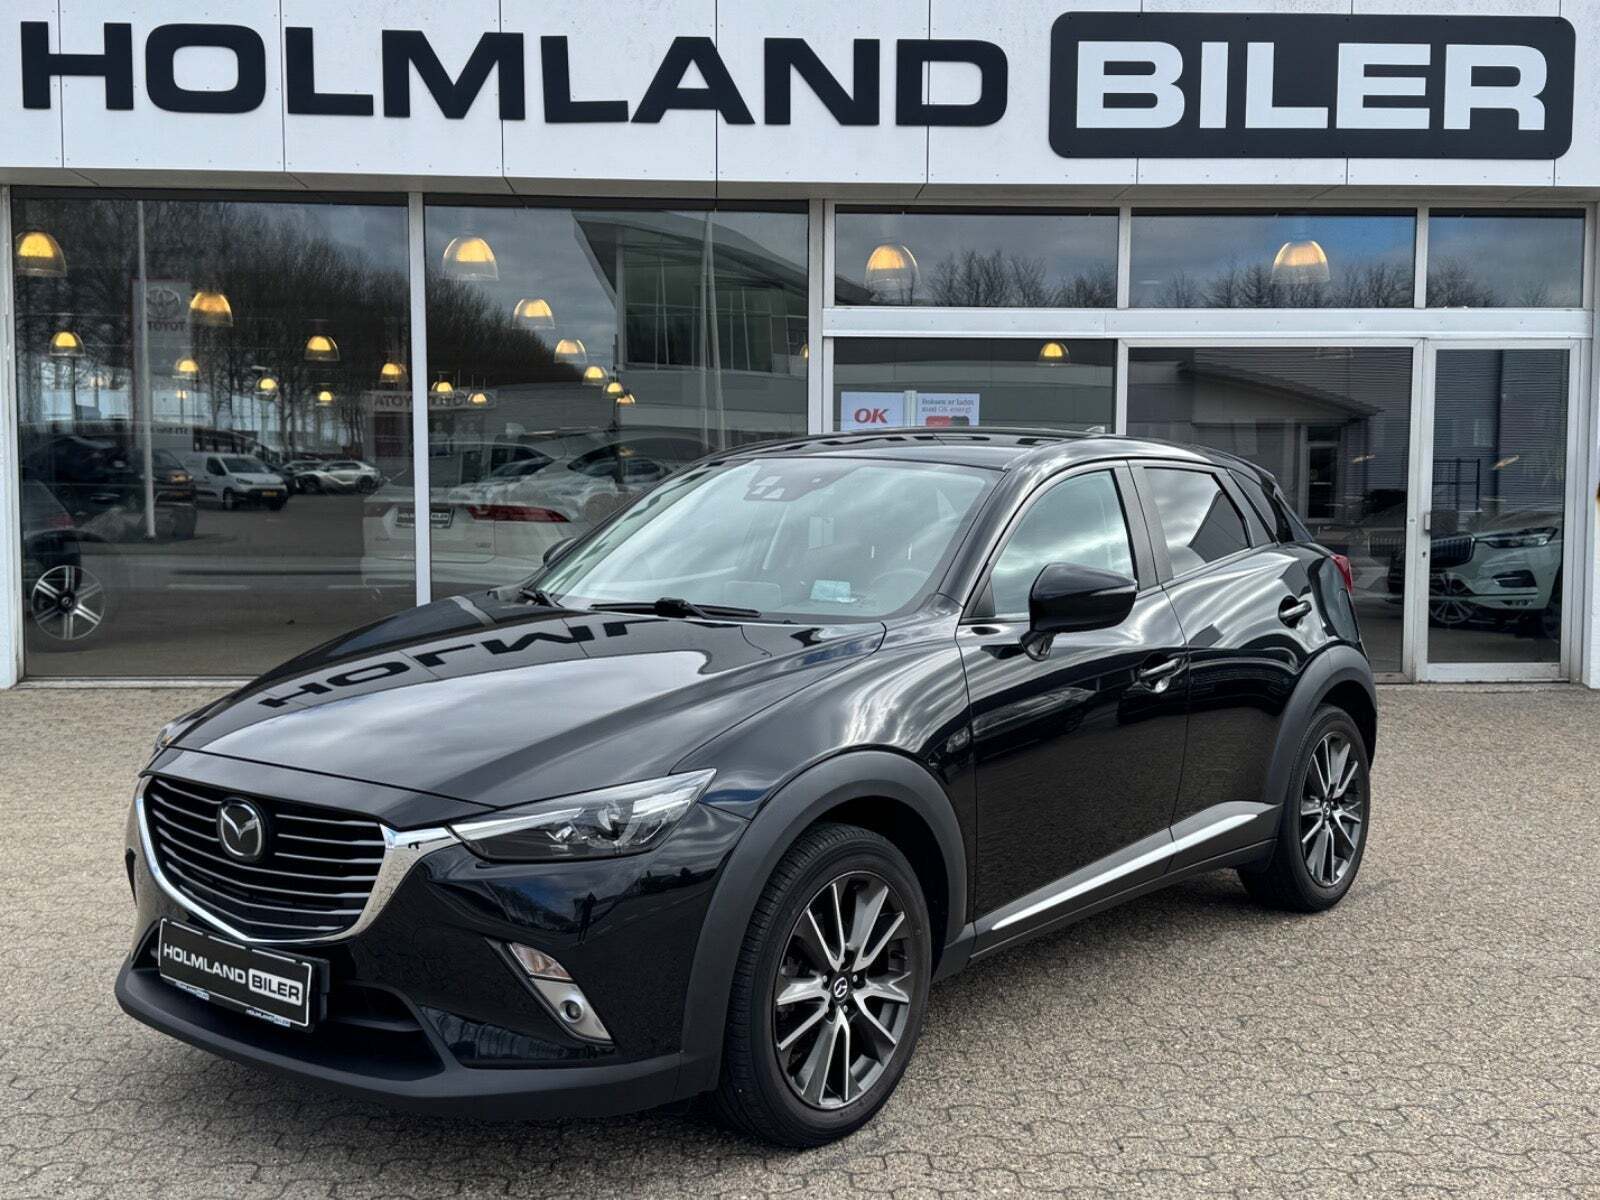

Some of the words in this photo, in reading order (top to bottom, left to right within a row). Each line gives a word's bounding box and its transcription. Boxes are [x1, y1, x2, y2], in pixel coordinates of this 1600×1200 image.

[21, 21, 1008, 127] HOLMLAND
[1076, 41, 1548, 132] BILER
[854, 408, 889, 423] OK
[163, 943, 246, 985] HOLMLAND
[252, 975, 300, 1001] BILER
